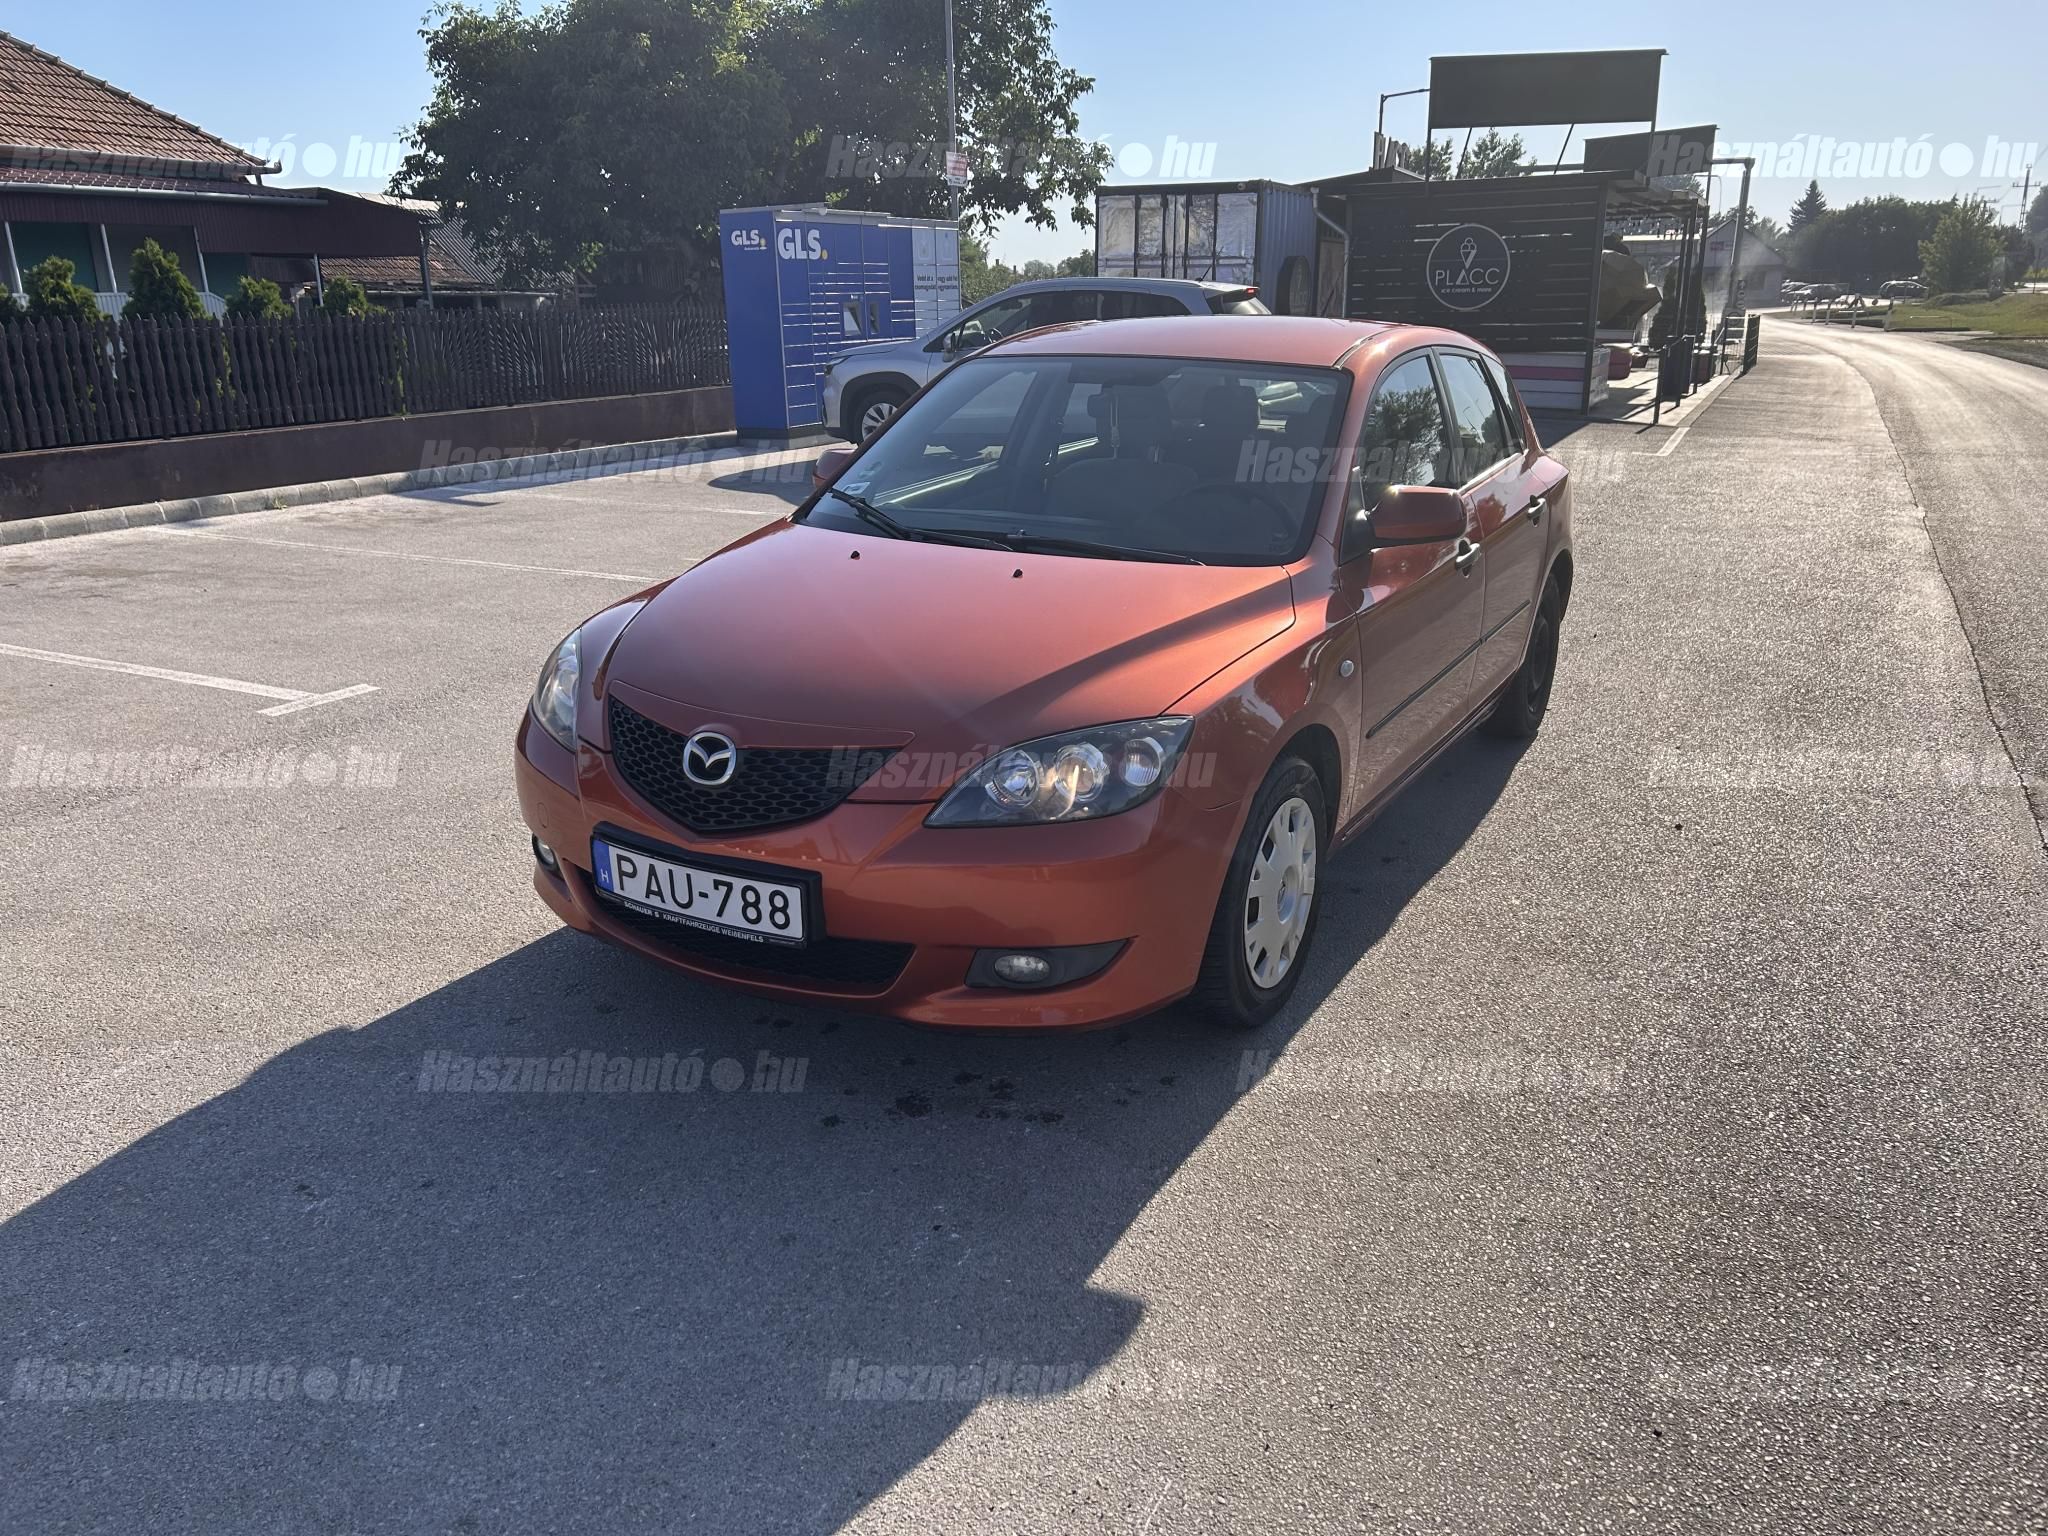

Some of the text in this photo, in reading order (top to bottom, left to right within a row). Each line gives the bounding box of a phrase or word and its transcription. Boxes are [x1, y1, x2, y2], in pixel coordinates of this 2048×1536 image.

[1435, 267, 1501, 286] PLACC
[600, 868, 609, 883] H
[616, 853, 791, 930] PAU-788
[624, 900, 653, 918] SCHAUER
[662, 913, 720, 934] KRAFTFAHRZEUGE
